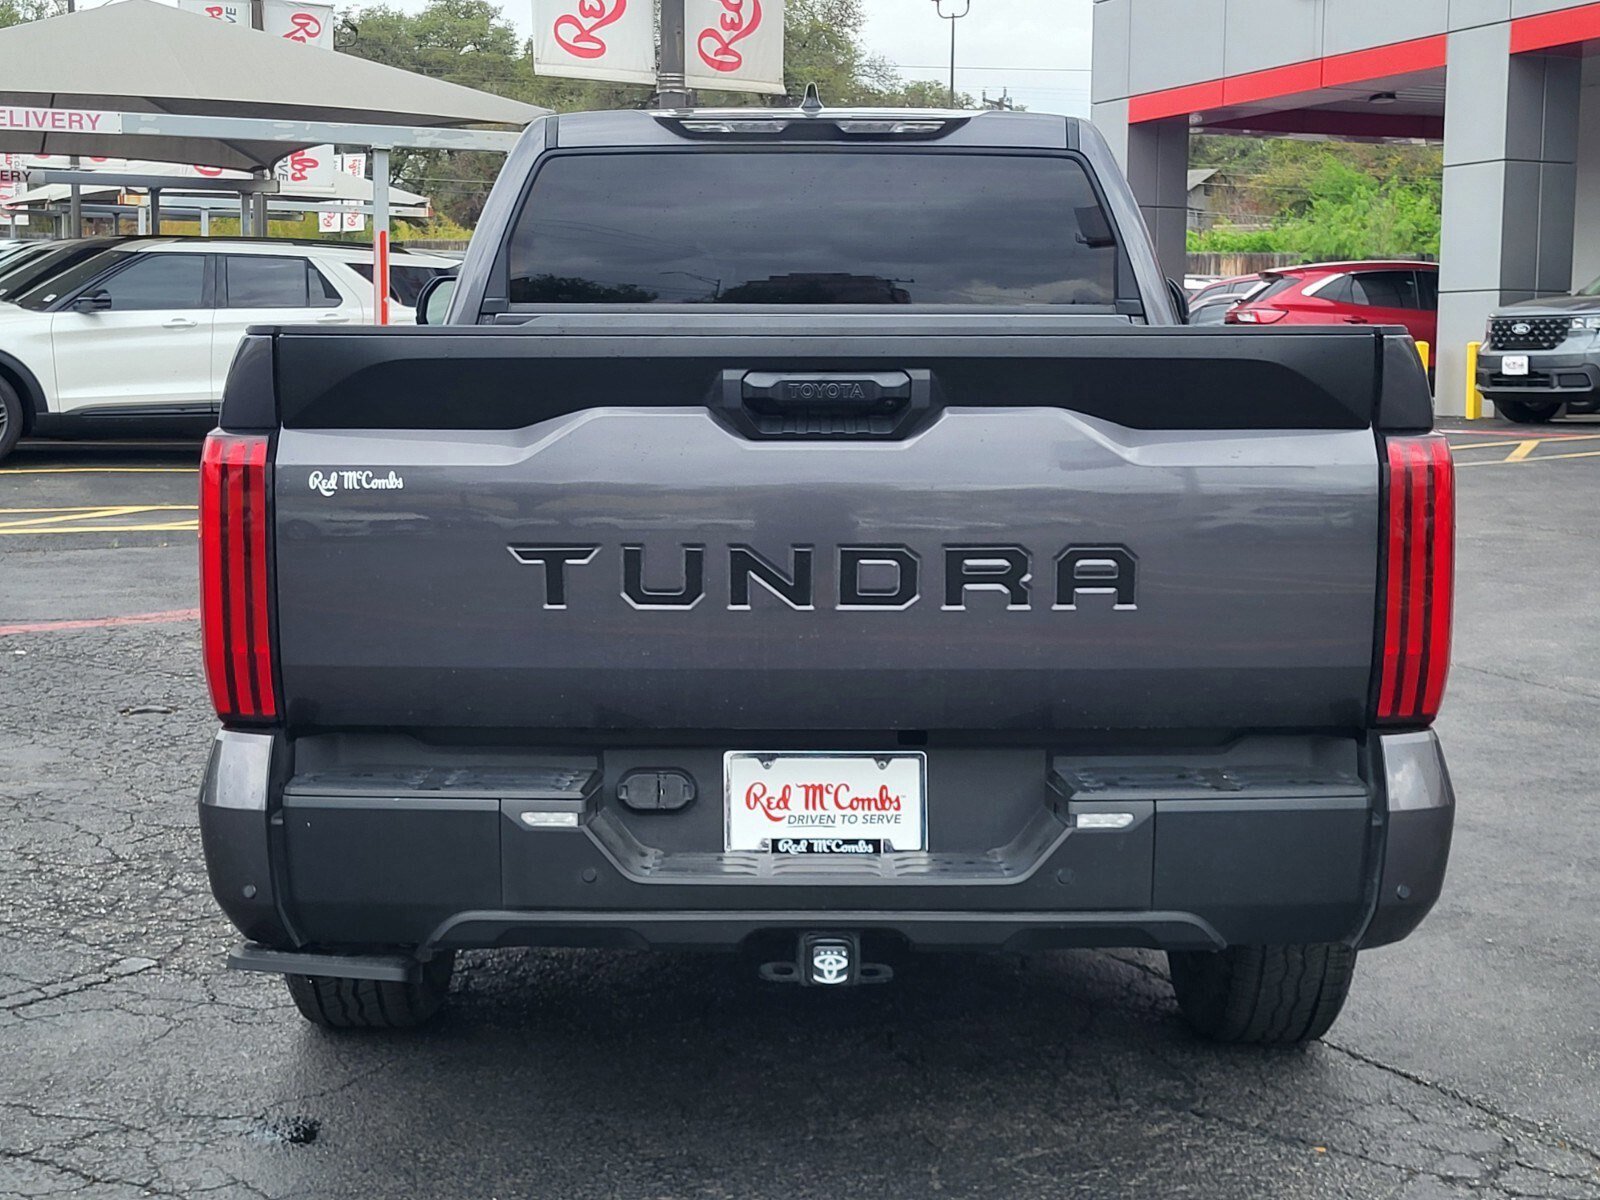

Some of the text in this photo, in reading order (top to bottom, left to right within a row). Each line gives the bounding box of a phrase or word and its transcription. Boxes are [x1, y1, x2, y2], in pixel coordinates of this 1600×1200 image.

[554, 0, 627, 58] Re
[788, 383, 865, 399] TOYOTA
[308, 470, 404, 497] Red McCombs
[507, 543, 1139, 611] TUNDRA
[745, 782, 901, 822] Red McCombs
[787, 814, 902, 825] DRIVEN TO SERVE
[778, 838, 874, 854] Red McCombs
